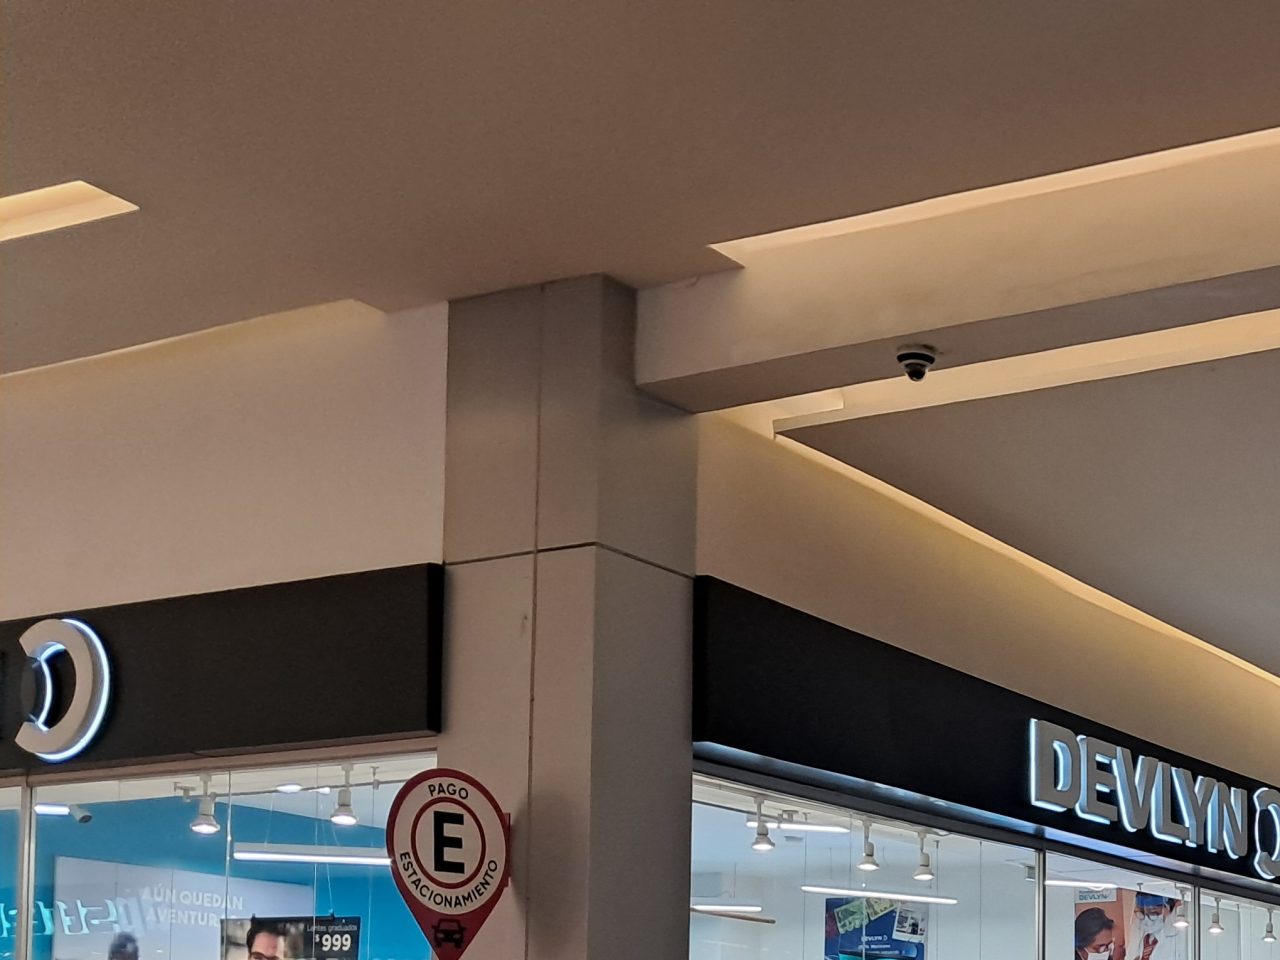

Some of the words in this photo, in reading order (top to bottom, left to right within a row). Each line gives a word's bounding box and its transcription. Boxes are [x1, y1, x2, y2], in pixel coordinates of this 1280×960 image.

[428, 783, 469, 800] PAGO
[1030, 718, 1248, 859] DEVLYN
[433, 810, 465, 874] E
[400, 851, 498, 909] ESTACIONAMIENTO
[146, 908, 236, 928] AVENTUR
[179, 890, 243, 910] QUEDAN
